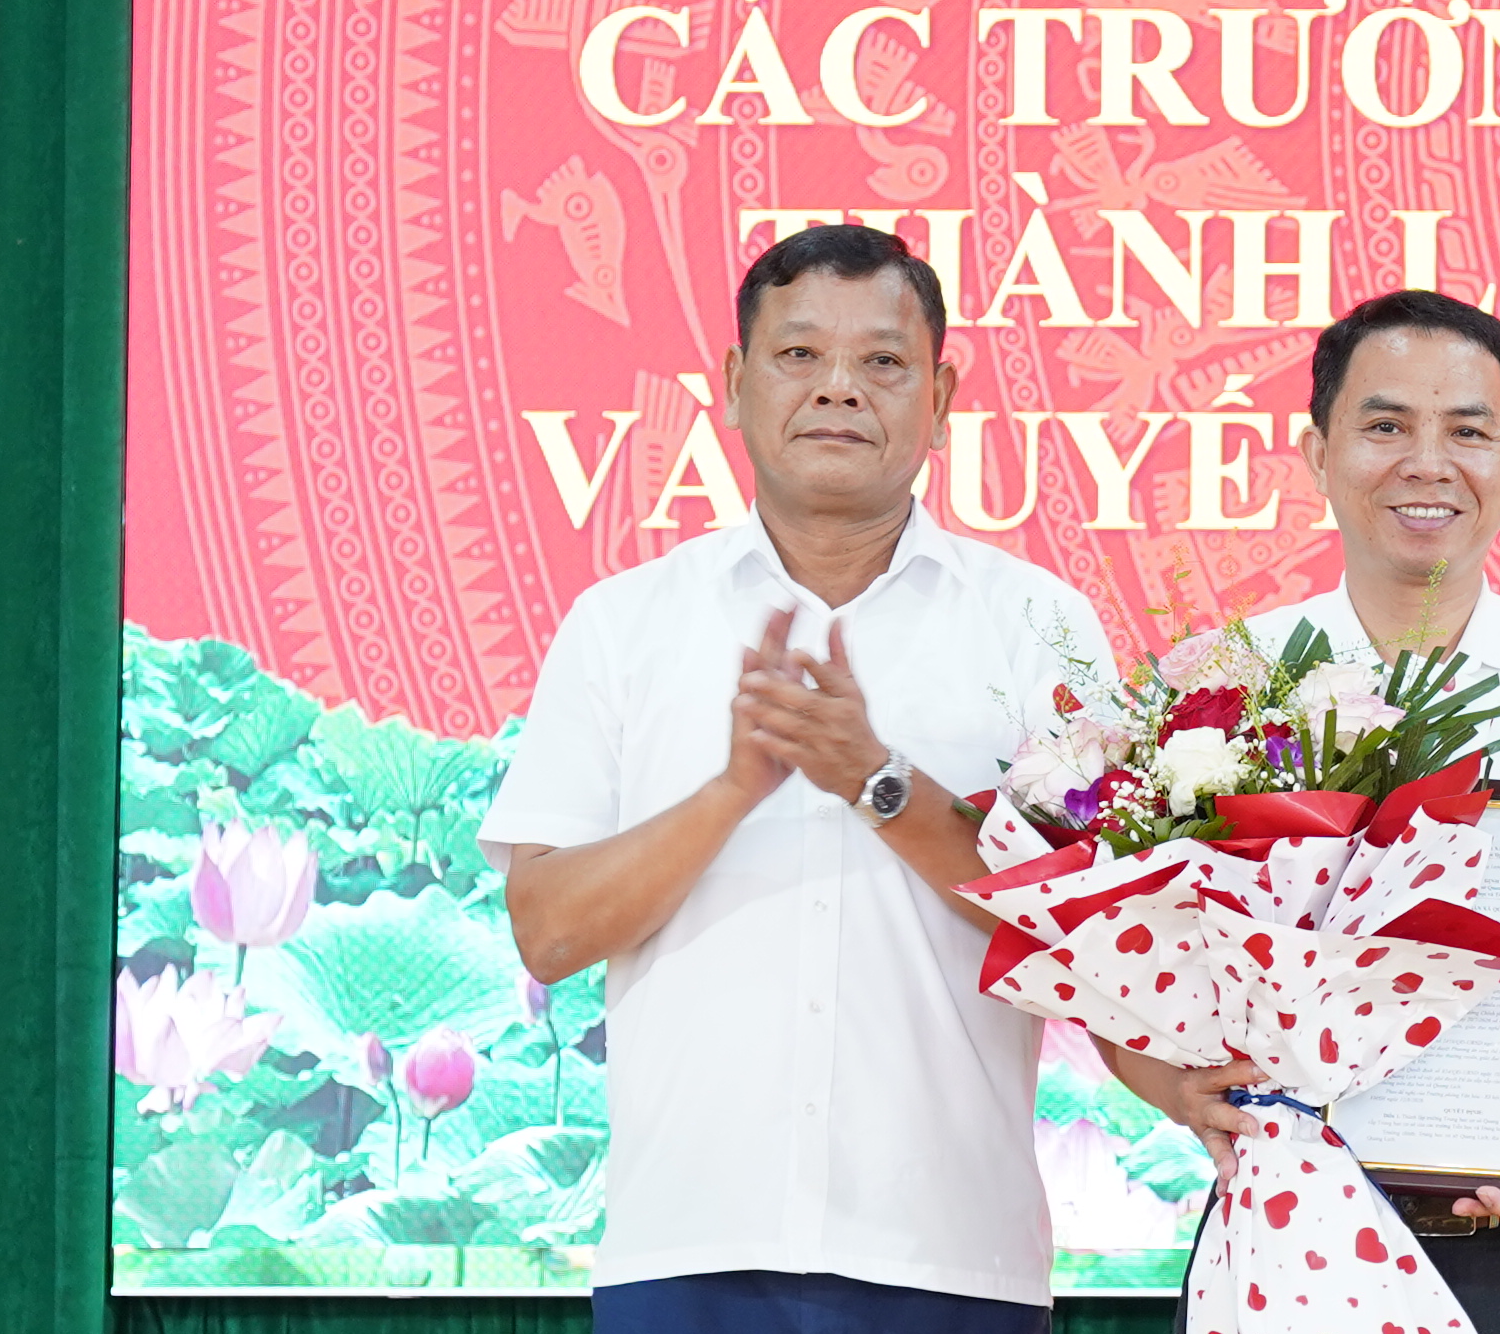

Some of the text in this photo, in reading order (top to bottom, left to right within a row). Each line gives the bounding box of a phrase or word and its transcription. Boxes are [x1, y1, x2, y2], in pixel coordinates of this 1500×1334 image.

[738, 170, 1346, 330] HÀNH
[520, 371, 752, 531] VÀ
[922, 372, 1340, 532] UYẾ
